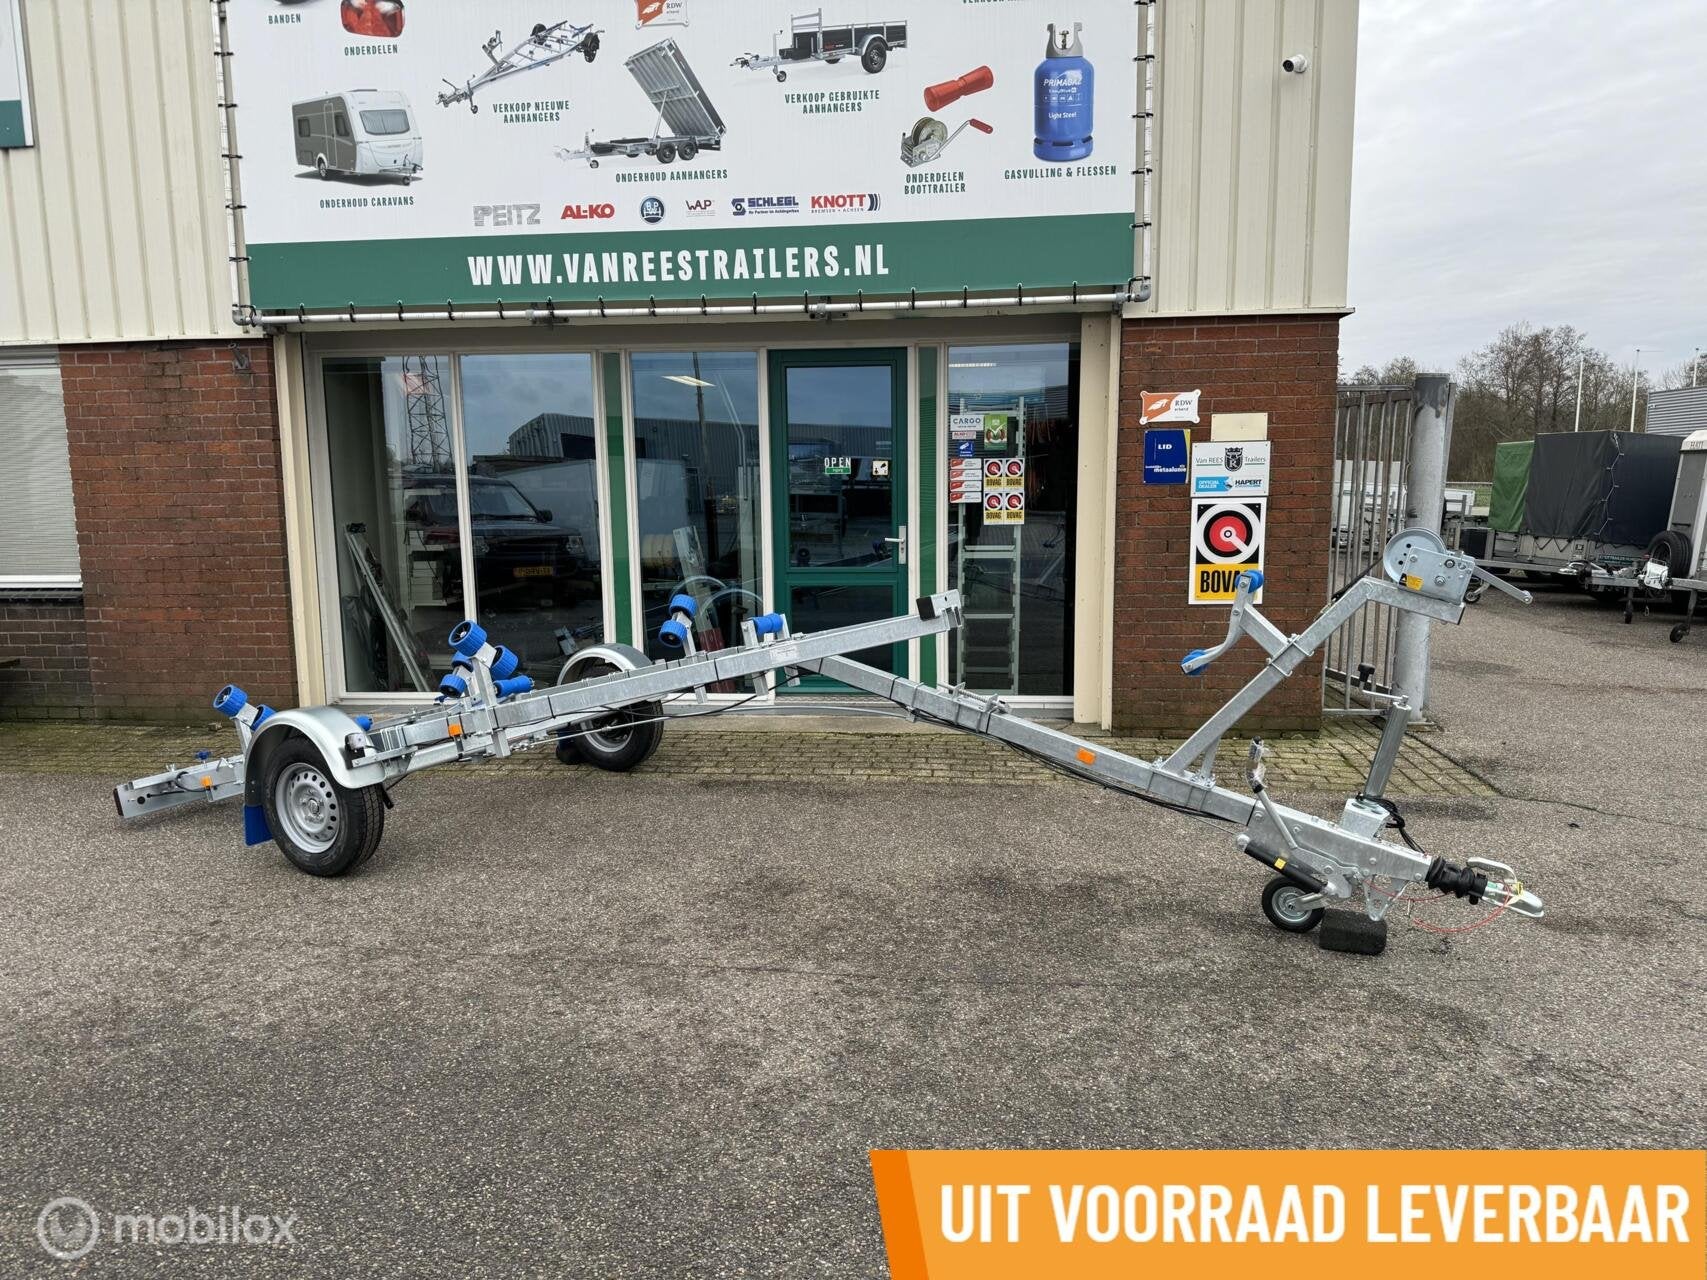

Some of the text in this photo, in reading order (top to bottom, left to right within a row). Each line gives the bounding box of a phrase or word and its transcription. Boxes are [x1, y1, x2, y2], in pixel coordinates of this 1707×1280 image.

[268, 13, 301, 24] BANDEN
[344, 44, 398, 56] ONDERDELEN
[785, 89, 880, 104] VERKOOP GEBRUIKTE
[493, 100, 570, 113] VERKOOP NIEUWE
[802, 101, 862, 114] AANHANGERS
[503, 111, 560, 124] AANHANGERS
[615, 169, 728, 183] ONDERHOUD AANHANGERS
[905, 171, 964, 184] ONDERDELEN
[1004, 165, 1117, 180] GASVULLING & FLESSEN
[904, 182, 966, 195] BOOTTRAILER
[319, 196, 414, 209] ONDERHOUD CARAVANS
[747, 196, 799, 207] SCHLEGL
[811, 194, 866, 208] KNOTT
[473, 203, 541, 226] PEITZ
[560, 203, 615, 220] AL-KO
[467, 243, 890, 286] WWW.VANREESTRAILERS.NL
[1175, 399, 1193, 407] RDW
[952, 417, 981, 425] CARGO
[824, 457, 851, 468] OPEN
[1208, 456, 1224, 464] REES
[1244, 455, 1266, 463] Trailers
